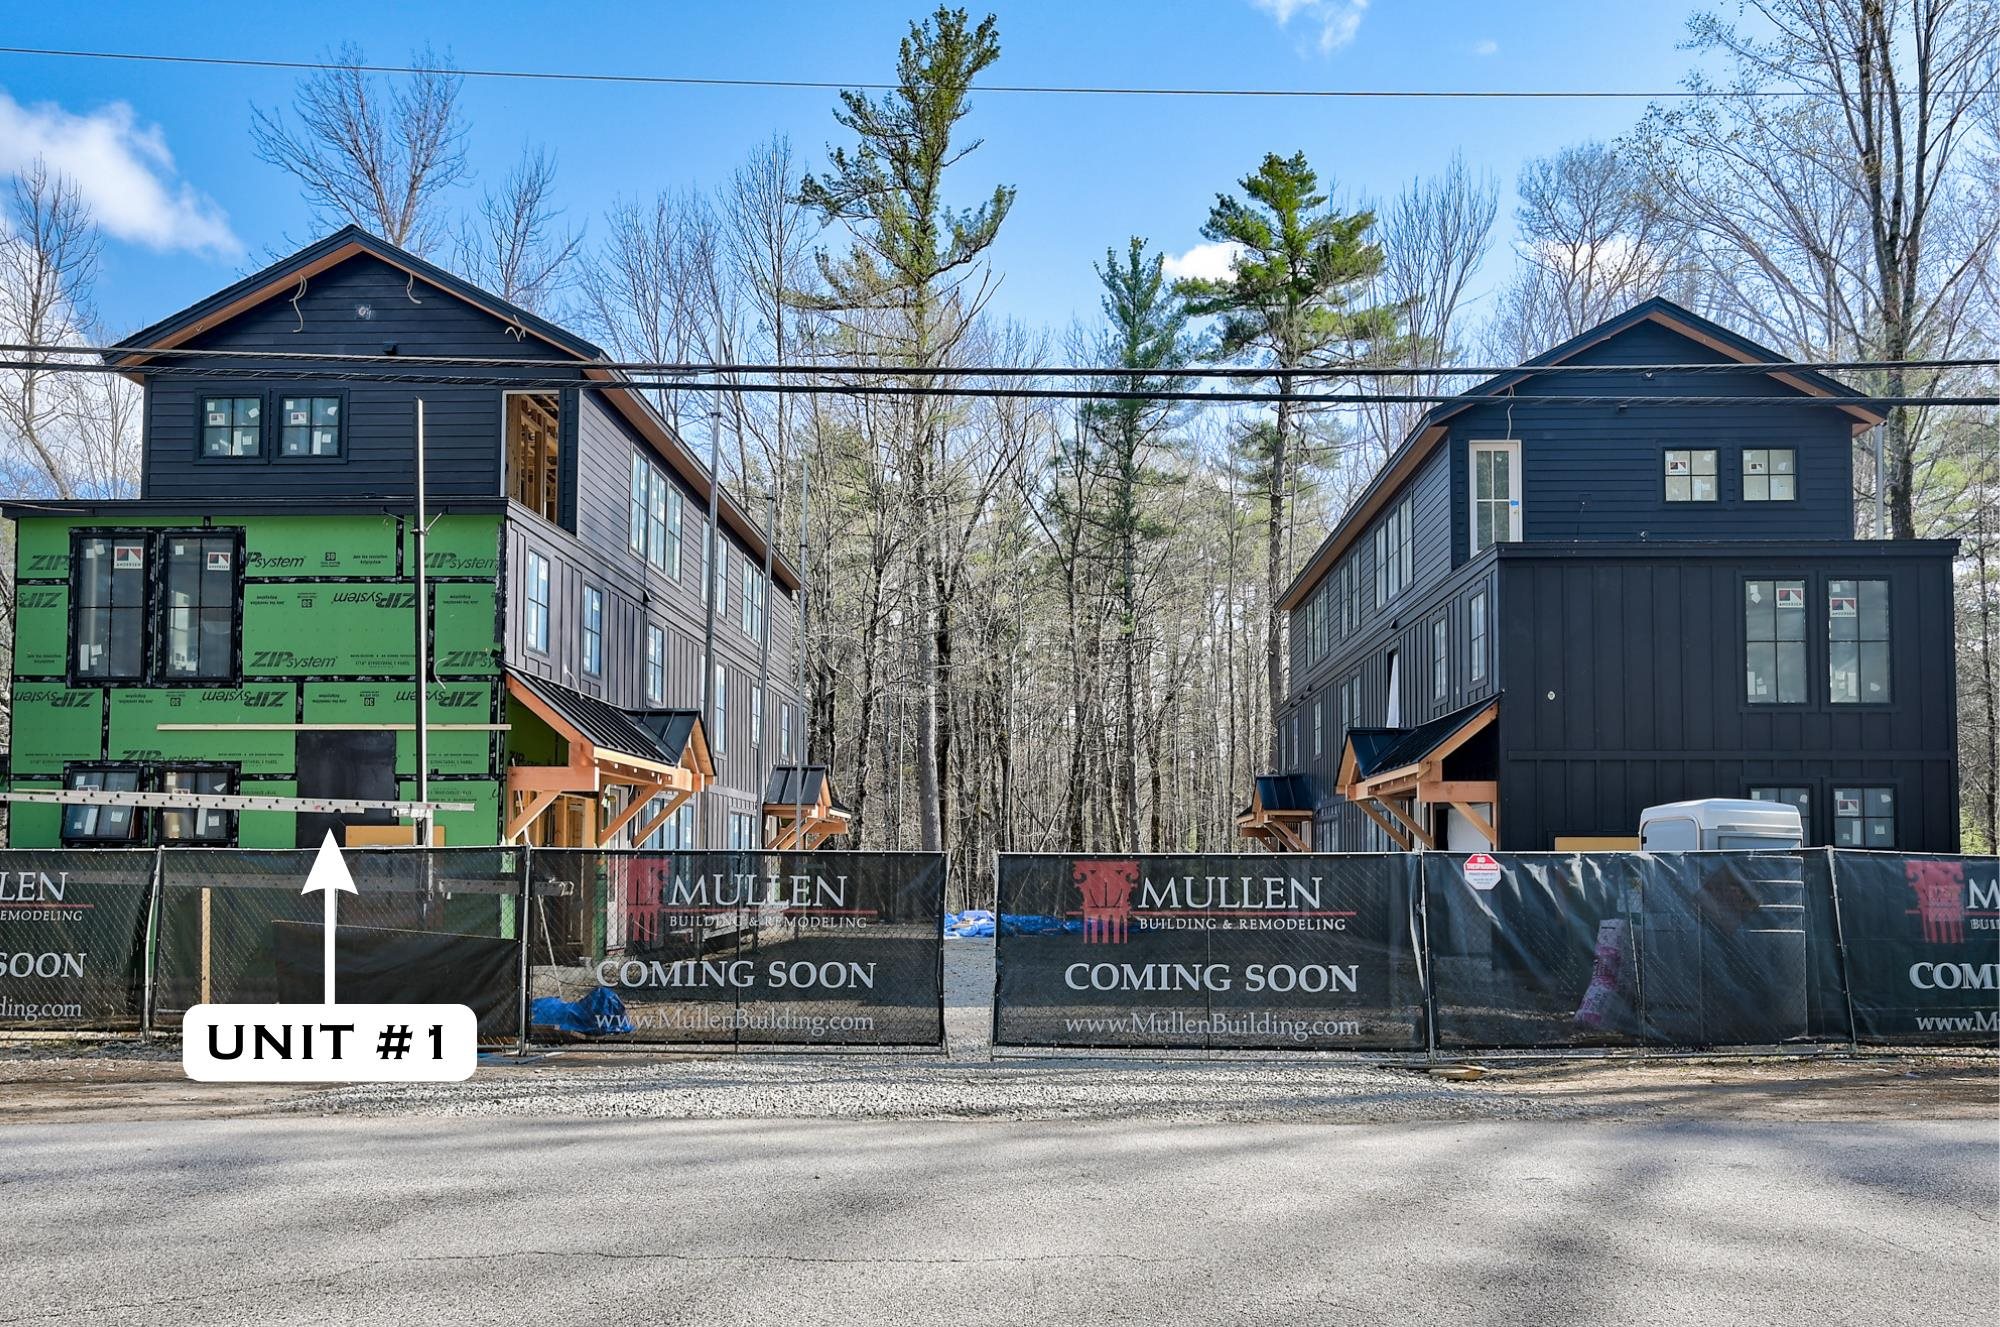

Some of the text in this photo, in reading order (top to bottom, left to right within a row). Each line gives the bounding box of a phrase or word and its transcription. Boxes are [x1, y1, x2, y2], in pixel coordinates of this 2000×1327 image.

[668, 874, 848, 907] MULLEN
[1138, 876, 1323, 909] MULLEN
[669, 916, 867, 928] BUILDING & REMODELING
[1140, 918, 1346, 931] BUILDING & REMODELING
[596, 960, 877, 988] COMING SOON
[1065, 963, 1359, 992] COMING SOON
[595, 1008, 875, 1037] www.MullenBuilding.com
[1064, 1010, 1360, 1042] www.MullenBuilding.com
[1916, 1011, 1998, 1032] www.M
